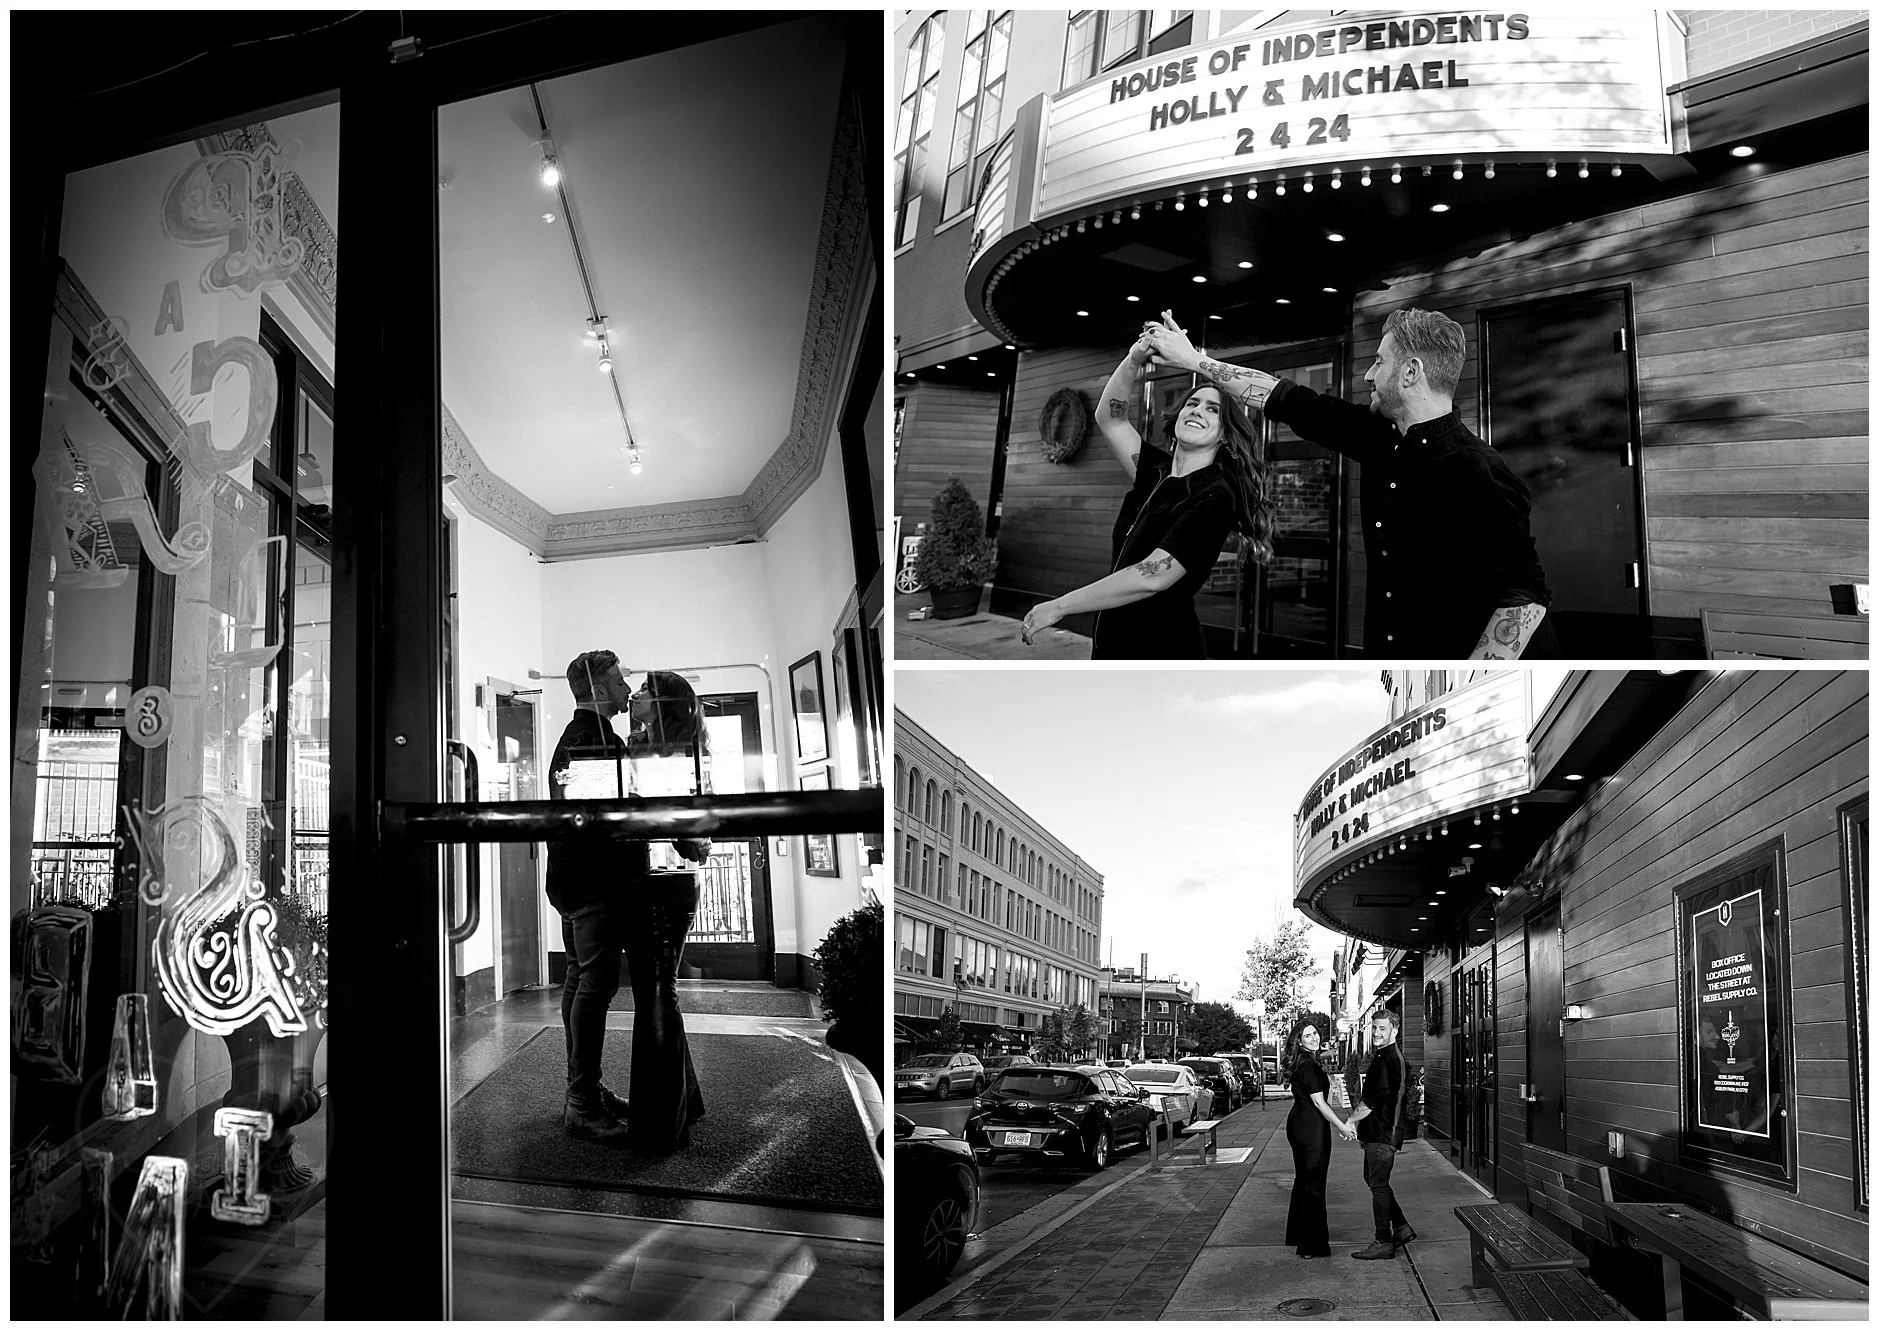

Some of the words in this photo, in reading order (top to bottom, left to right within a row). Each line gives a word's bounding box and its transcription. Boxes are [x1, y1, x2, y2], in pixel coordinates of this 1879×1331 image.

[1110, 56, 1198, 104] HOUSE
[1209, 44, 1250, 76] OF
[1262, 14, 1529, 66] INDEPENDENTS
[1150, 85, 1248, 131] HOLLY
[1262, 79, 1285, 106] &
[1302, 60, 1469, 101] MICHAEL
[1235, 128, 1254, 155] 2
[1270, 122, 1290, 149] 4
[1306, 114, 1351, 145] 24
[1324, 772, 1336, 797] OF
[1338, 708, 1446, 786] INDEPENDENTS
[1311, 801, 1336, 838] HOLLY
[1339, 794, 1347, 814] &
[1351, 758, 1415, 807] MICHAEL
[1332, 831, 1339, 850] 2
[1342, 823, 1349, 842] 4
[1353, 812, 1369, 838] 24
[1706, 969, 1731, 980] LOCATED
[1732, 964, 1752, 975] DOWN
[1712, 959, 1724, 968] BOX
[1724, 953, 1745, 966] OFFICE
[1703, 993, 1722, 1003] REBEL
[1722, 989, 1745, 1000] SUPPLY
[1746, 987, 1758, 996] CO.
[1708, 982, 1720, 991] THE
[1720, 978, 1742, 989] STREET
[1742, 976, 1751, 985] AT
